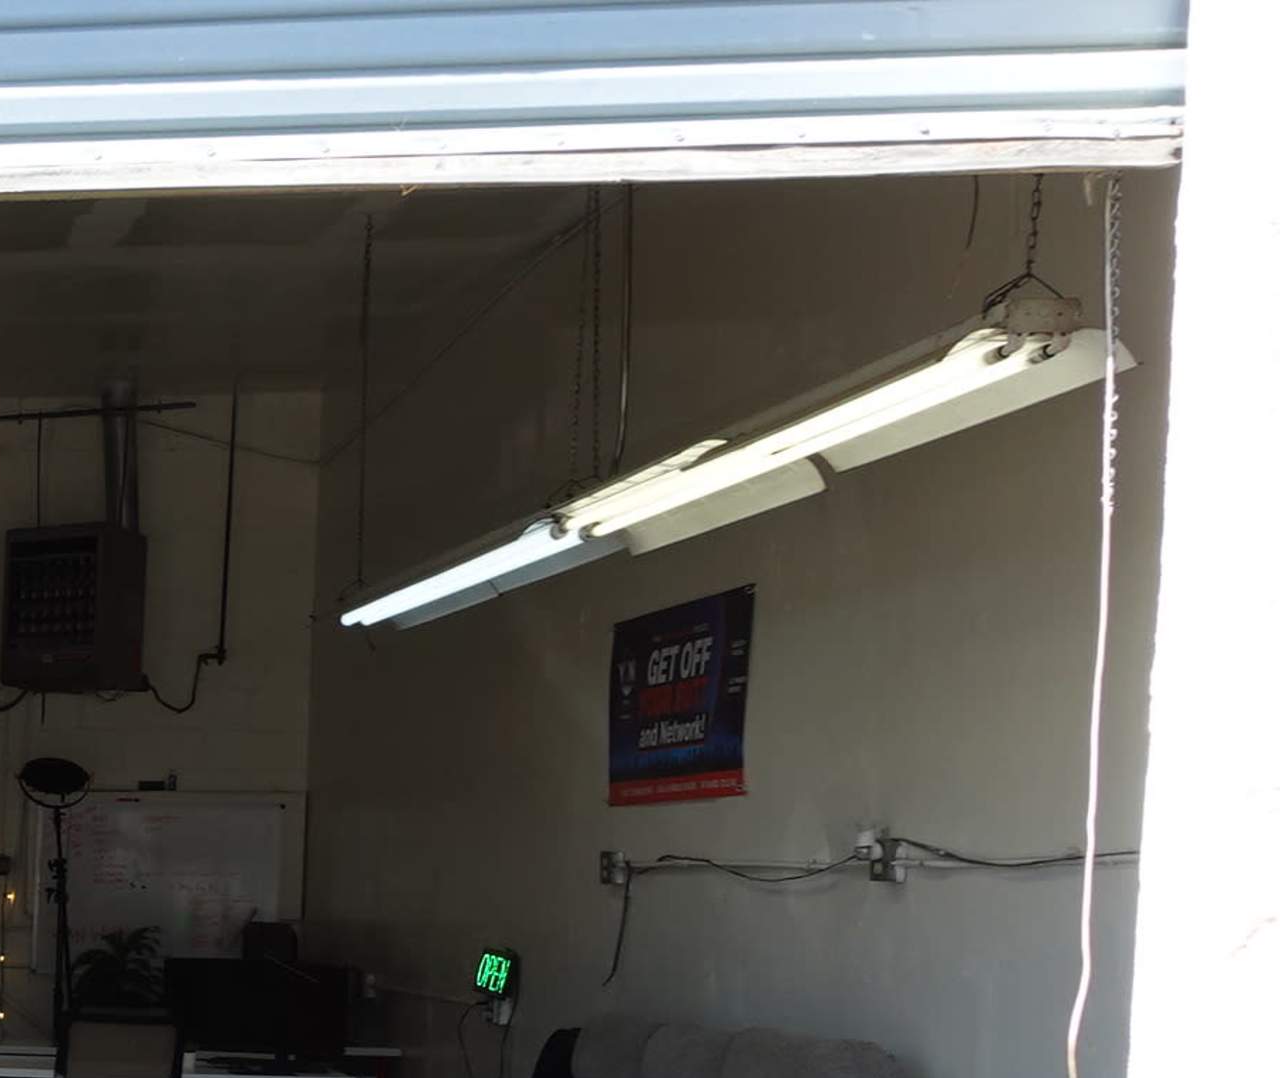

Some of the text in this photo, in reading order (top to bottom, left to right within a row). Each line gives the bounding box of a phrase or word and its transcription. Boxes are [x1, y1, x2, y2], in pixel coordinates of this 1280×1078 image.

[647, 644, 680, 686] GET
[680, 636, 714, 679] OFF
[638, 722, 659, 748] and
[476, 953, 512, 995] OPEN
